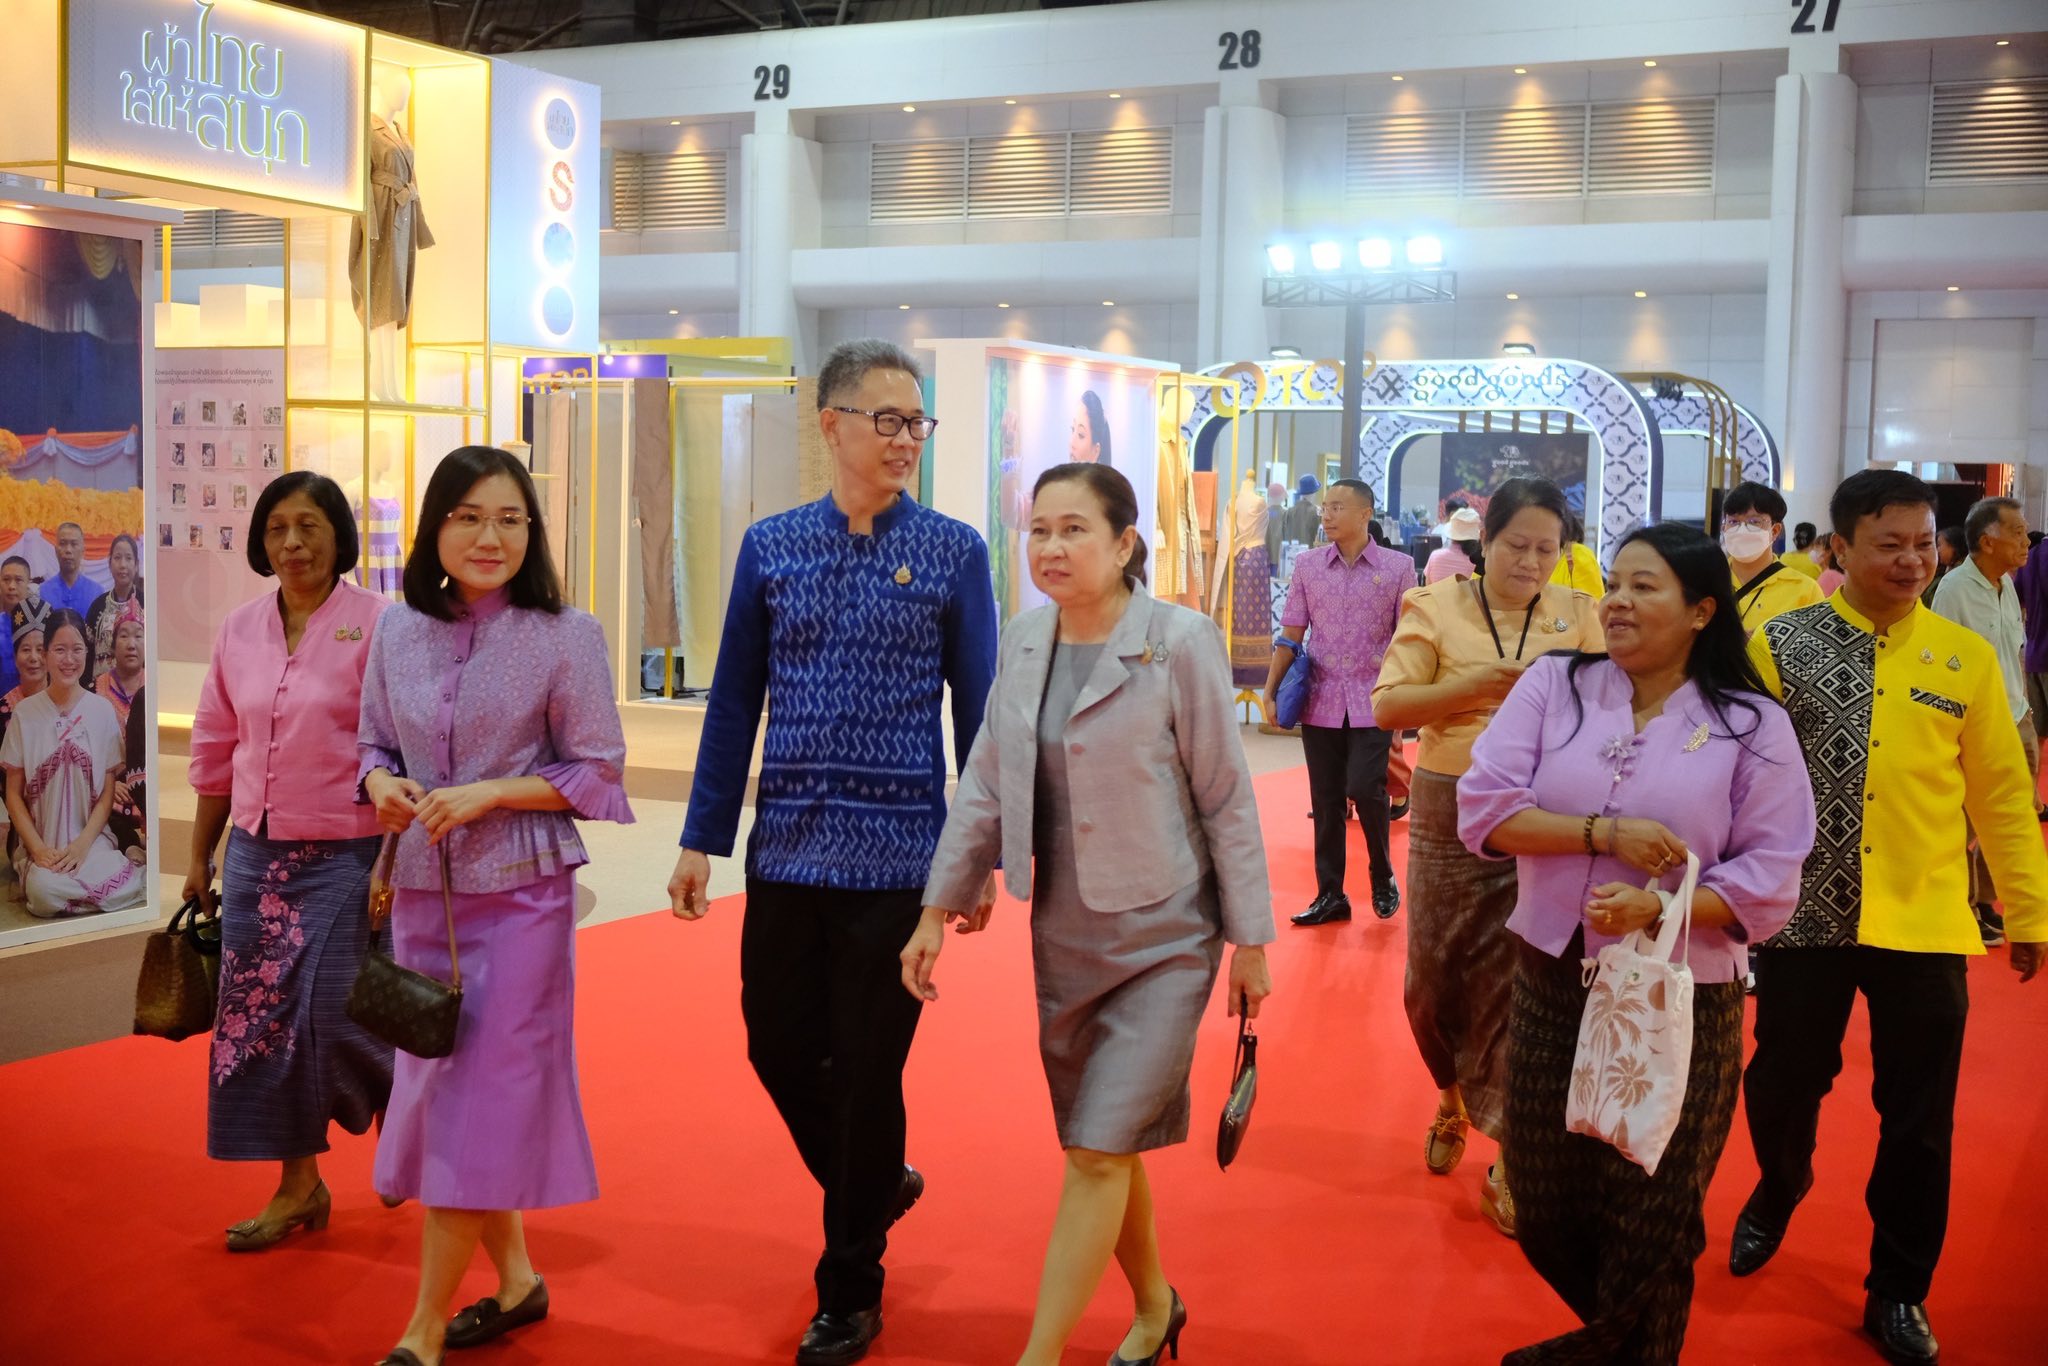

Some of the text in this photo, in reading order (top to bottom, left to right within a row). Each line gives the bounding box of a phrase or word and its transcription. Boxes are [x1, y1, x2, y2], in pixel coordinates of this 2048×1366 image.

[1791, 0, 1840, 34] 27
[142, 0, 284, 99] ผ้าไทย
[1218, 29, 1262, 71] 28
[753, 64, 791, 101] 29
[119, 70, 312, 176] ใส่ให้สนุก
[1413, 365, 1479, 402] good
[1484, 365, 1567, 402] goods
